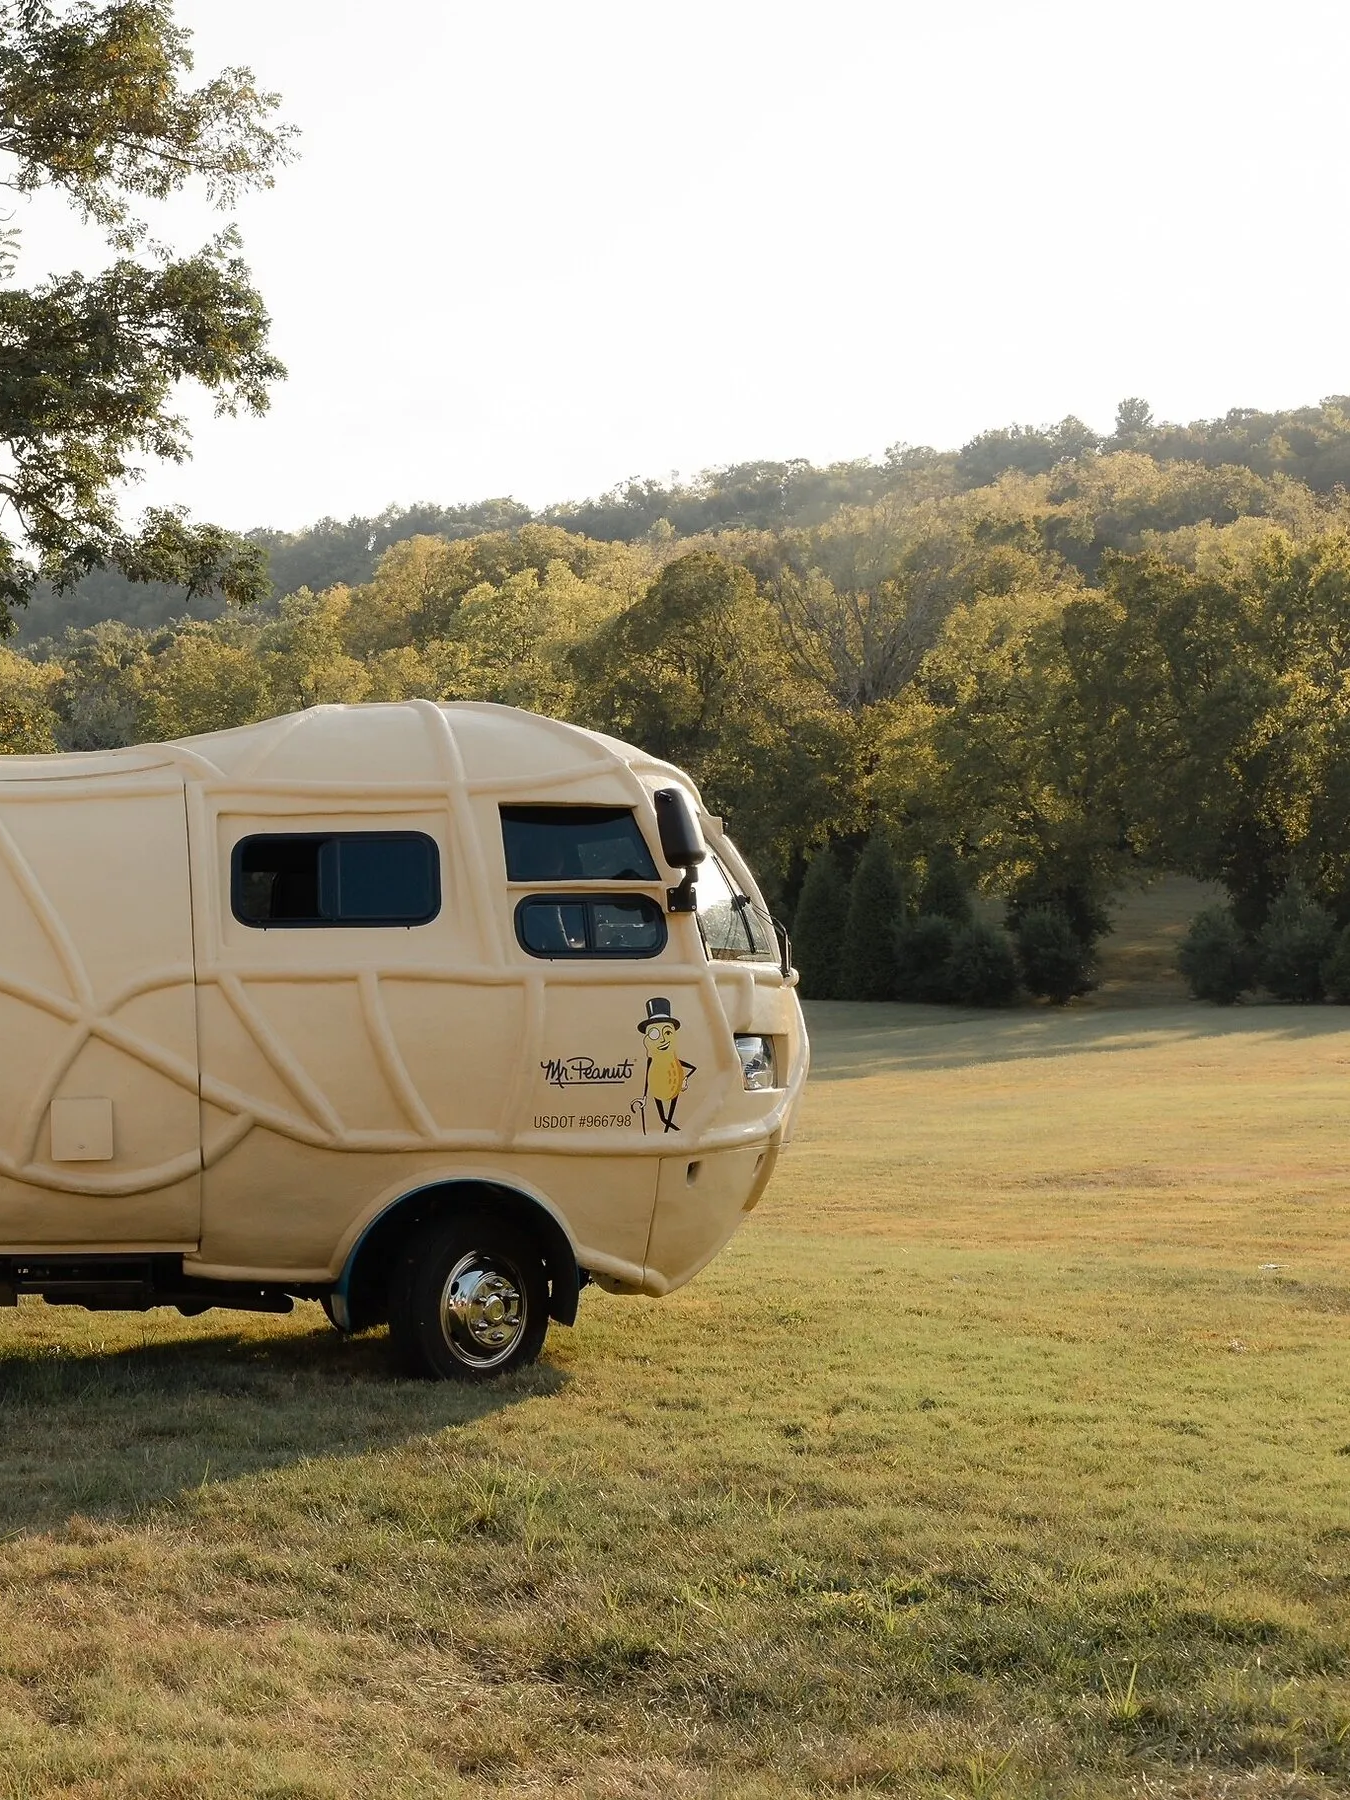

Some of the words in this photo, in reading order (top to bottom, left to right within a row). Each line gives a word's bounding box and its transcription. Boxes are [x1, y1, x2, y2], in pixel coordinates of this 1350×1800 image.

[540, 1058, 573, 1088] Mr.
[567, 1057, 634, 1080] Peanut
[534, 1115, 575, 1129] USDOT
[579, 1114, 632, 1128] #966798
